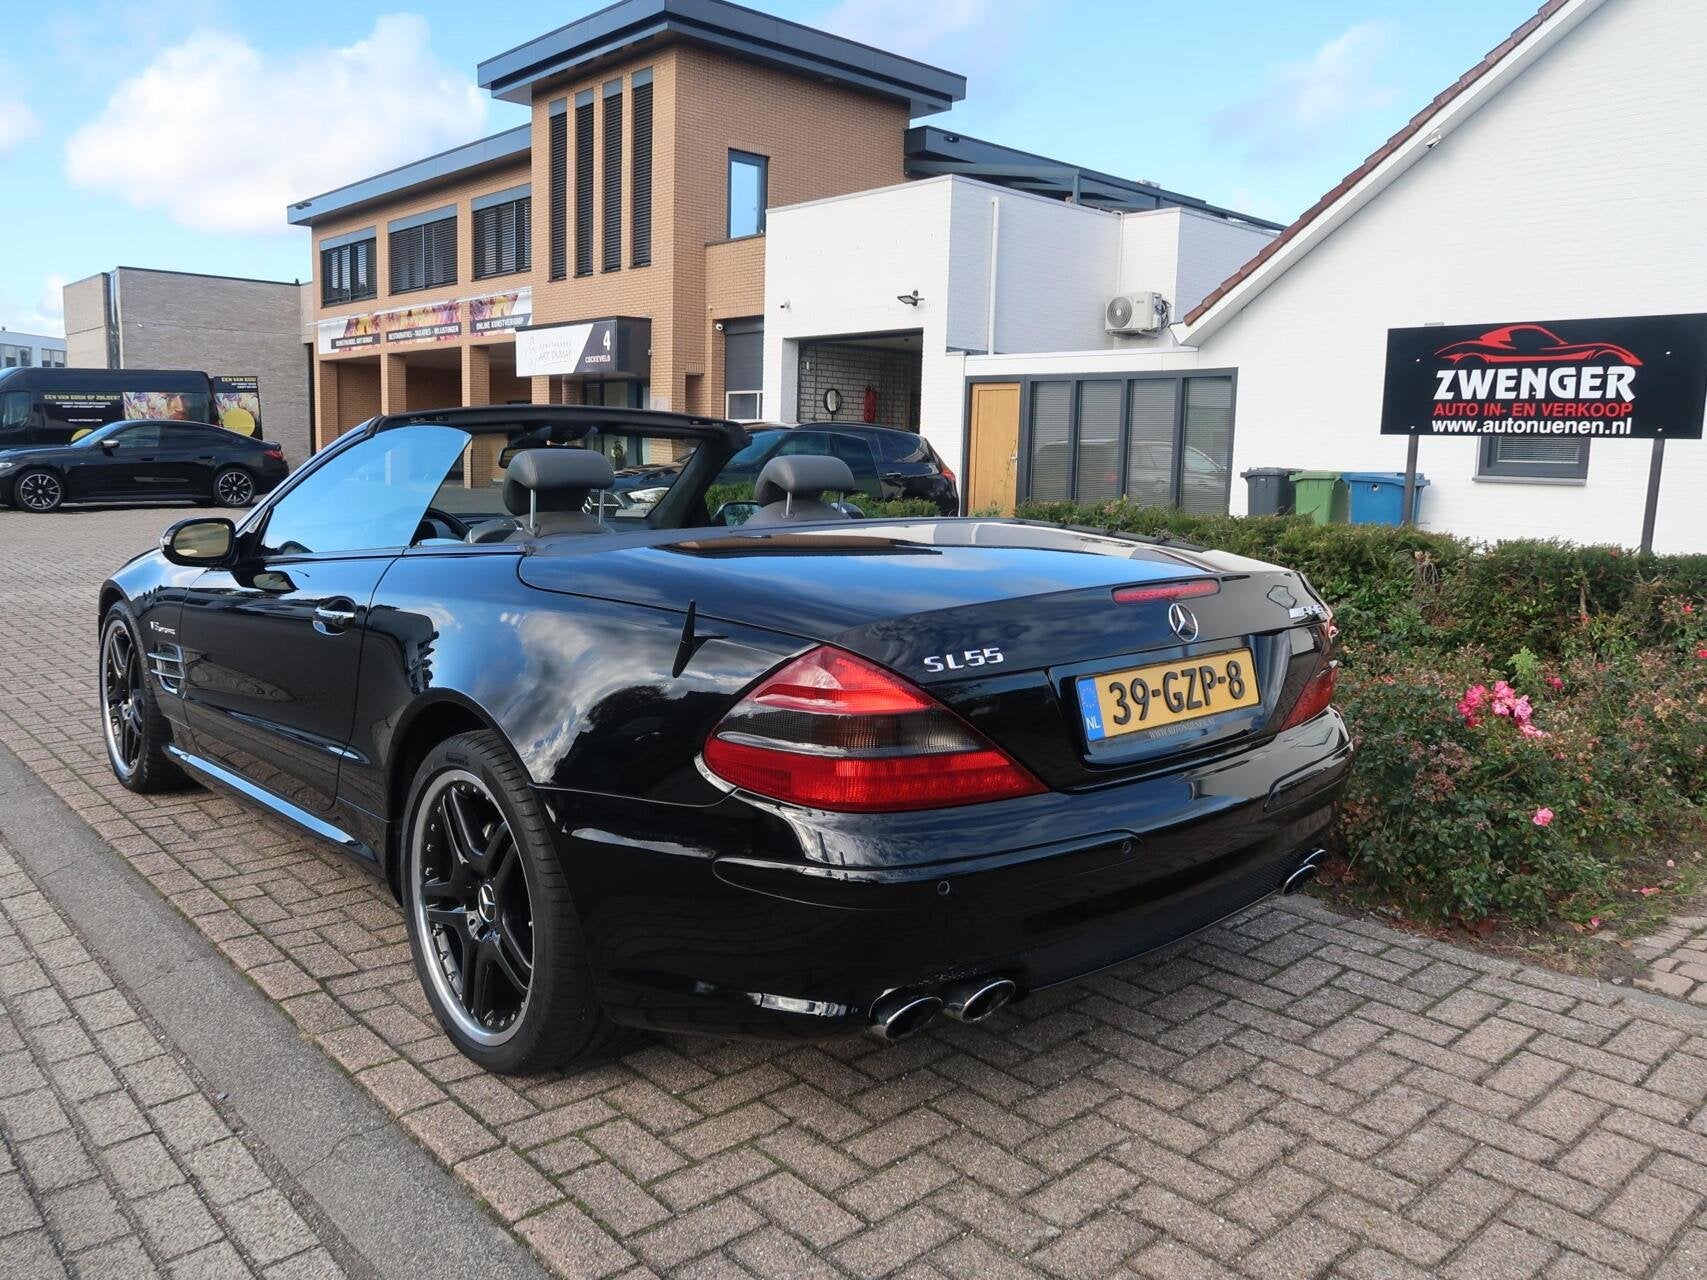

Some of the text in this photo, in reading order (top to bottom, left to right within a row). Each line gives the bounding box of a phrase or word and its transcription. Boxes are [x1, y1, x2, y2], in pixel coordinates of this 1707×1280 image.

[603, 330, 611, 351] 4
[1432, 365, 1637, 403] ZWENGER
[1433, 402, 1634, 418] AUTO IN- EN VERKOOP
[1432, 417, 1632, 435] www.autonuenen.nl
[923, 647, 1004, 673] SL55
[1108, 660, 1246, 726] 39-GZP-8
[1087, 716, 1101, 730] NL
